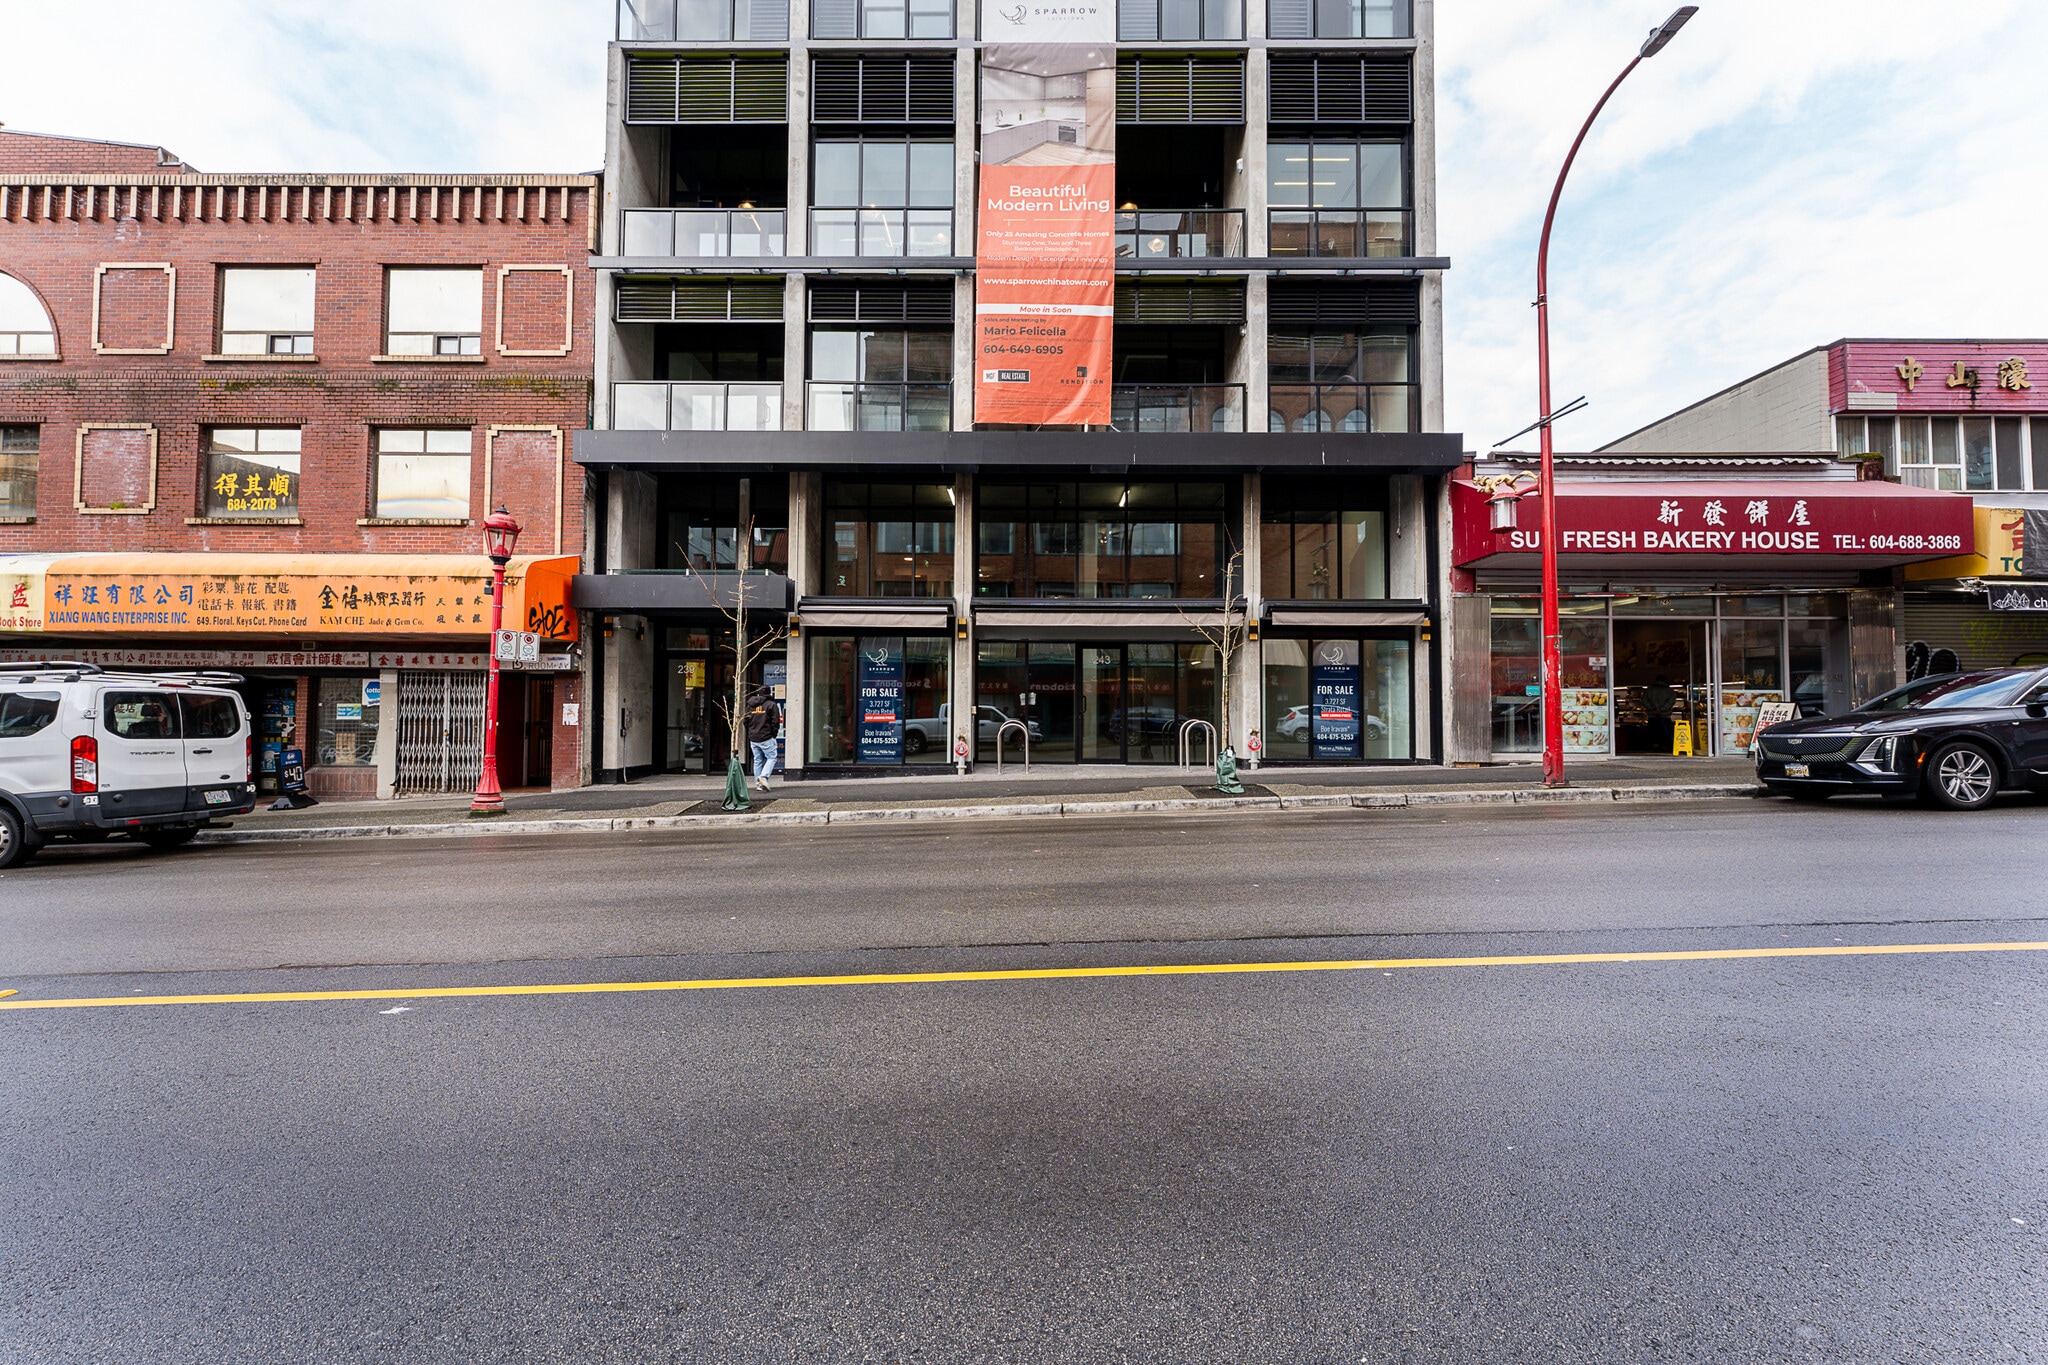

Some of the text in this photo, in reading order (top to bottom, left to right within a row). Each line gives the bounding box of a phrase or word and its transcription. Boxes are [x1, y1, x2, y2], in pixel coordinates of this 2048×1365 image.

[1034, 7, 1097, 15] SPARROW
[1009, 184, 1087, 197] Beautiful
[987, 198, 1110, 213] Modern Living
[986, 230, 1003, 239] Only
[1014, 231, 1048, 239] Amazing
[1076, 256, 1108, 264] Finishings
[983, 277, 1109, 288] www.sparrowchinatown.com
[983, 326, 1067, 336] Mario Felicella
[983, 344, 1064, 355] 604-649-6905
[1001, 372, 1011, 380] REAL
[1011, 372, 1026, 381] ESTATE
[213, 473, 290, 497] 得其順
[226, 497, 277, 511] 684-2078
[1656, 499, 1812, 527] 新發餅屋
[1510, 531, 1961, 550] SU FRESH BAKERY HOUSE TEL: 604-688-3868
[10, 583, 30, 609] 益
[54, 583, 194, 607] 祥旺有限公司
[19, 615, 42, 628] Store
[49, 611, 191, 625] XIANG WANG ENTERPRISE INC.
[196, 616, 211, 626] 649.
[269, 616, 290, 626] Phone
[291, 616, 307, 626] Card
[319, 616, 424, 627] KAM CHE Jade & Gem Co.
[266, 652, 343, 665] 威信會計師樓
[1092, 655, 1111, 665] 243
[677, 664, 695, 674] 239
[773, 664, 786, 674] 24
[862, 687, 898, 697] FOR SALE
[1317, 685, 1354, 695] FOR SALE
[284, 765, 303, 781] $40
